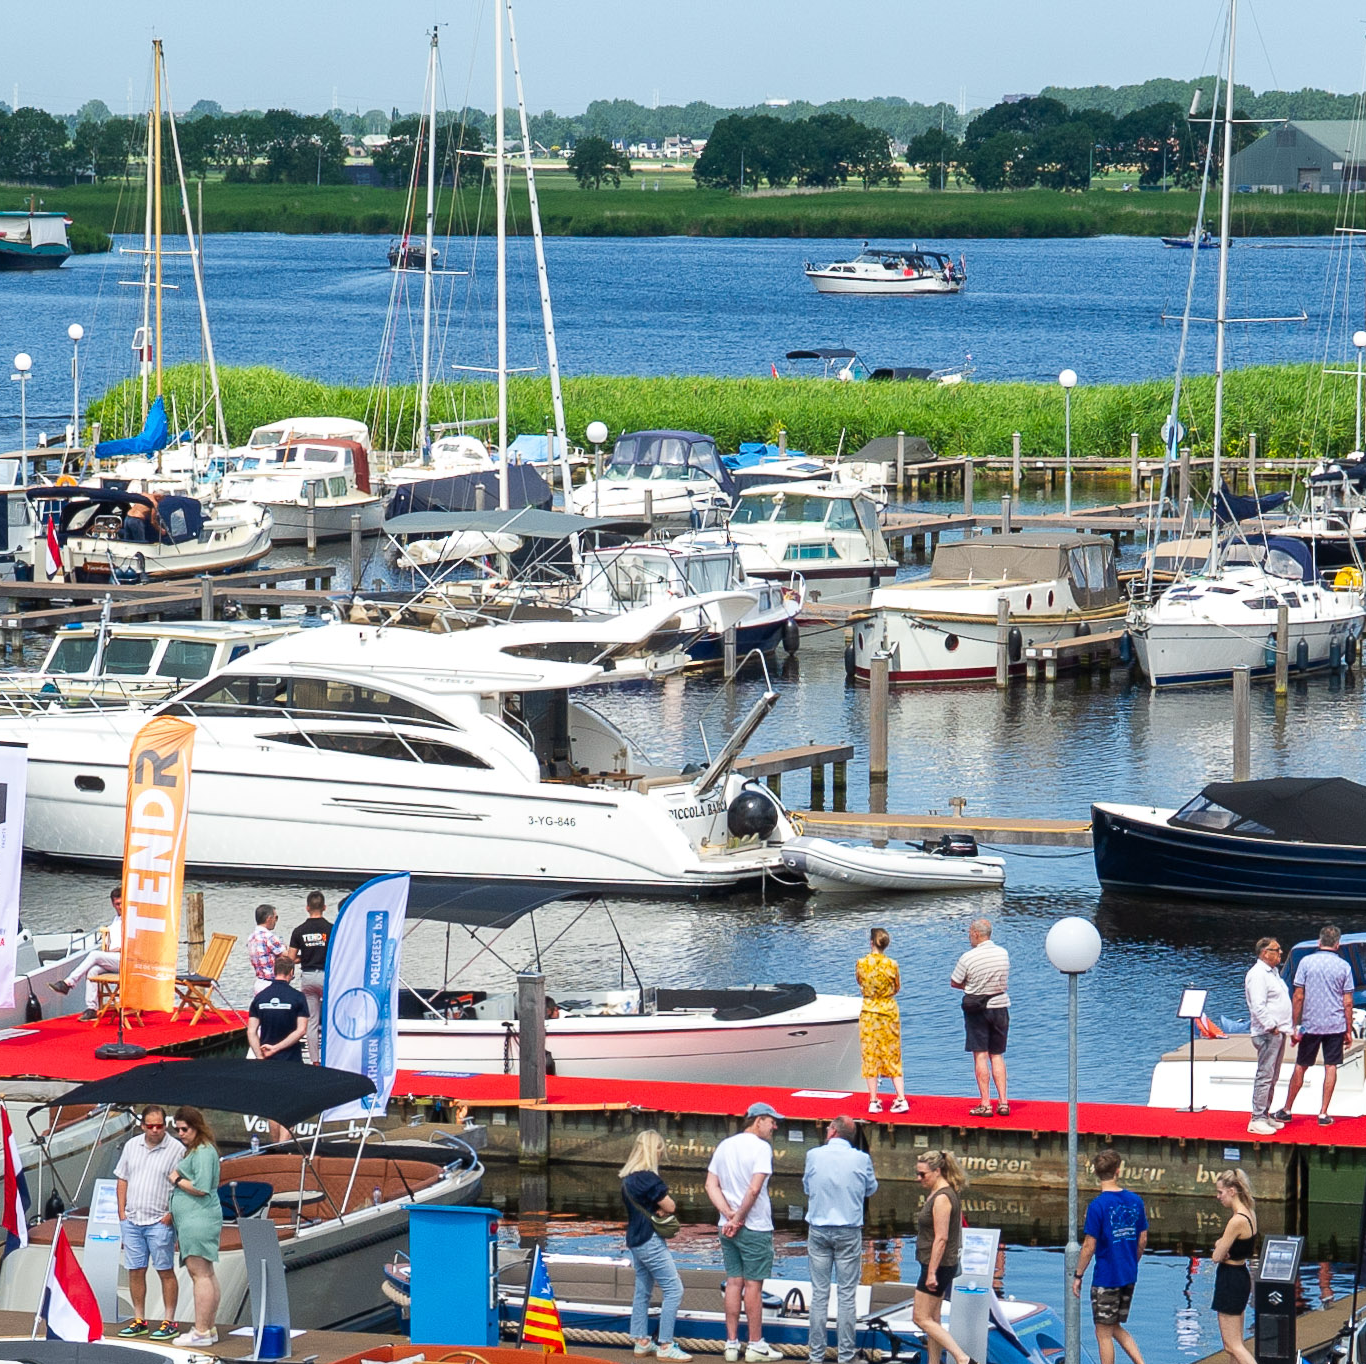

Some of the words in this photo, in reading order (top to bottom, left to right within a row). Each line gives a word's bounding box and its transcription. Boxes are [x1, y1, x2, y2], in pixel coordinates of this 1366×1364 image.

[127, 749, 179, 939] TENDR
[528, 815, 577, 827] 3-YG-846
[370, 933, 382, 986] POELGEEST
